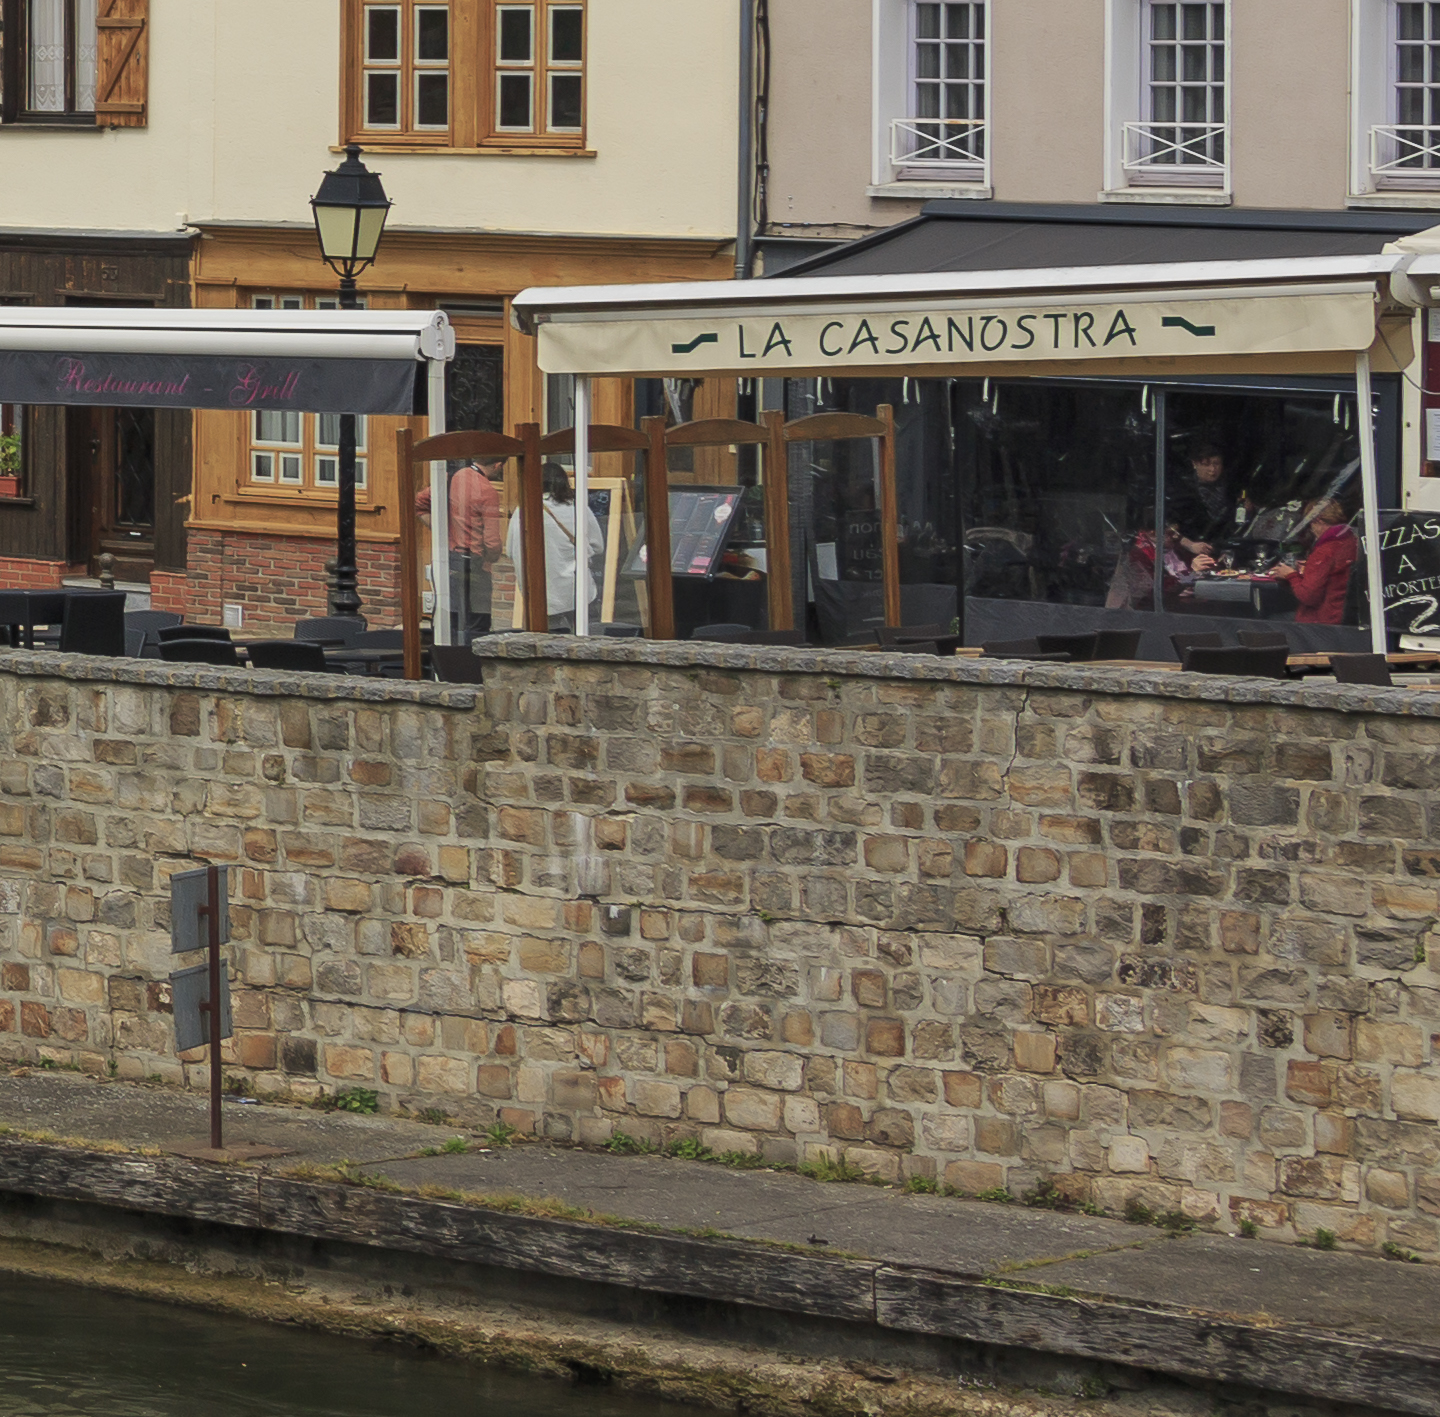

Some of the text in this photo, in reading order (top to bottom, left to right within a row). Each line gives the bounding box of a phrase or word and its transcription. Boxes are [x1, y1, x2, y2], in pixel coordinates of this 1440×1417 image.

[737, 309, 1138, 359] LA CASANOSTRA
[56, 356, 191, 395] Restaurant
[230, 362, 302, 407] Grill
[1361, 518, 1440, 555] ZZAS
[1397, 553, 1417, 574] A
